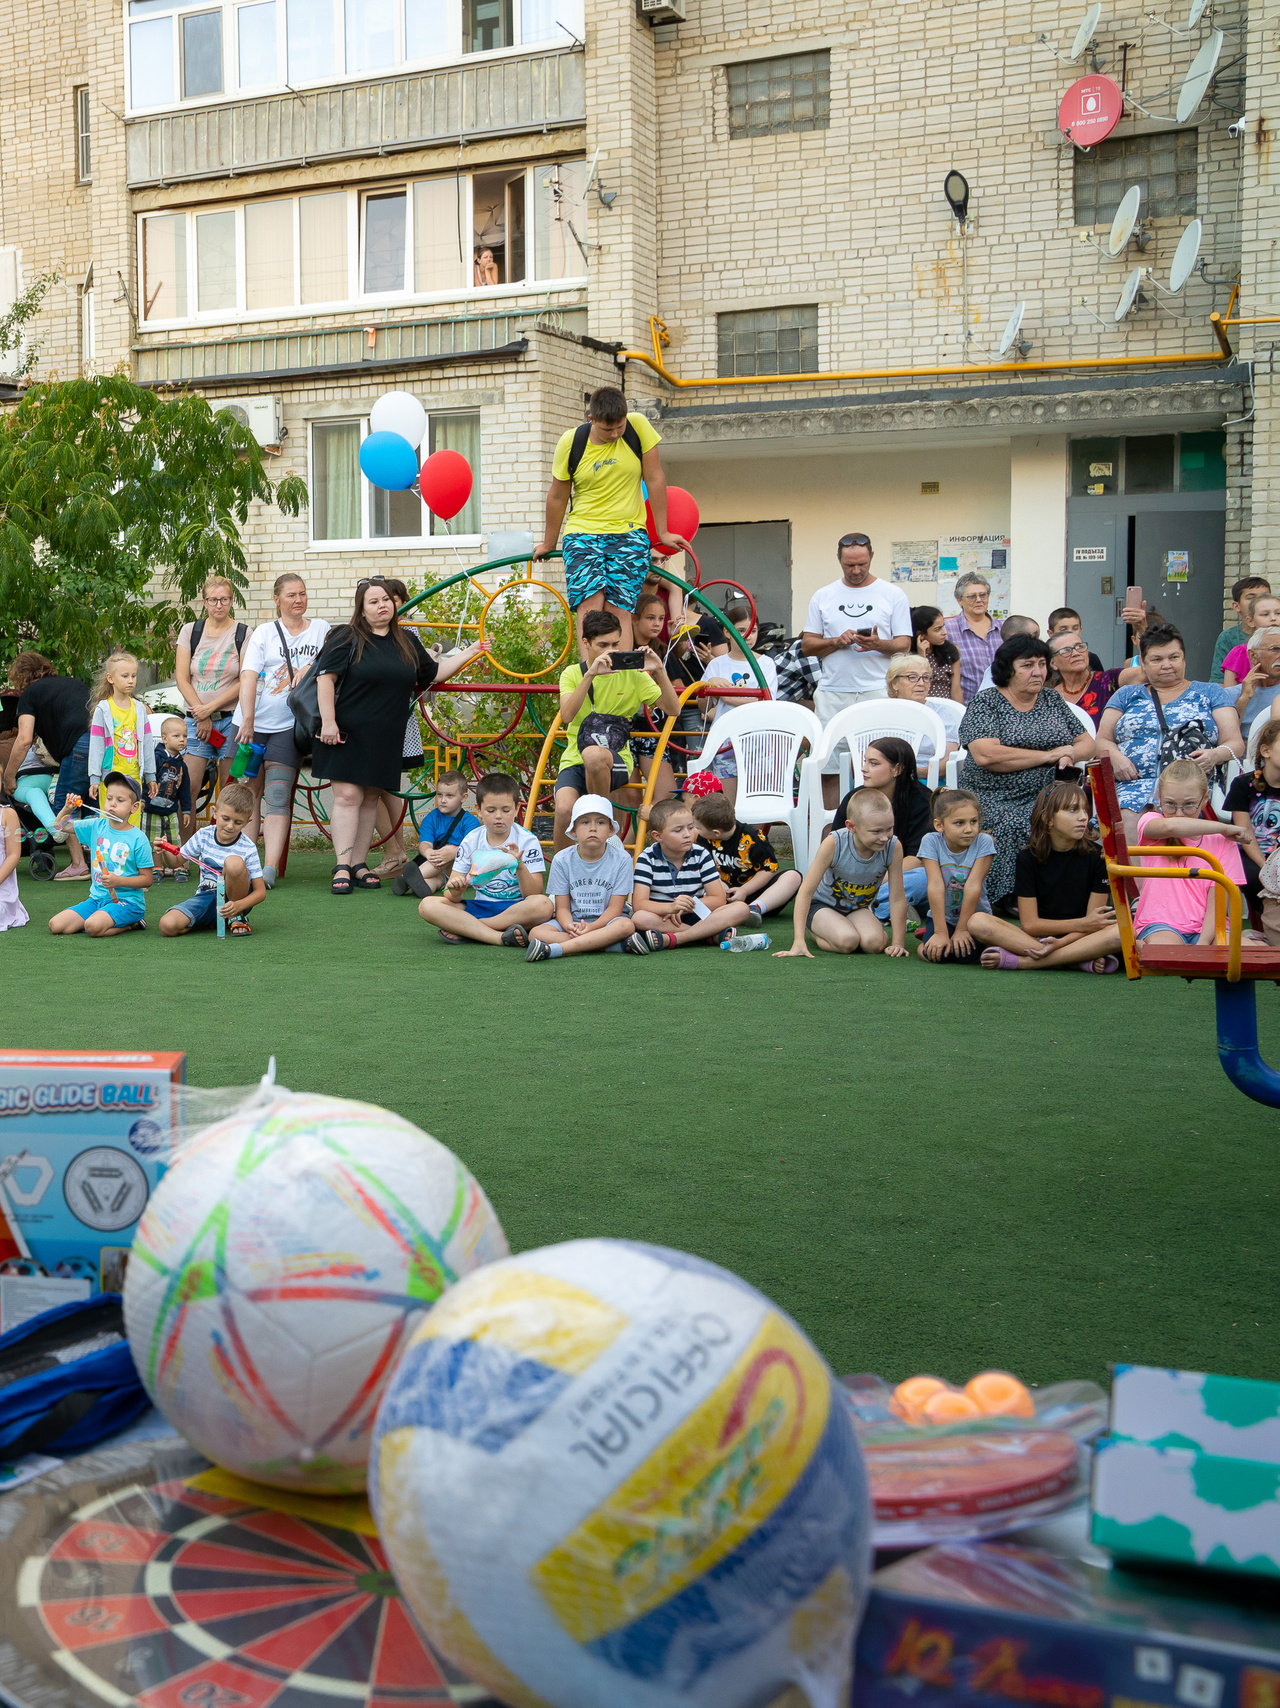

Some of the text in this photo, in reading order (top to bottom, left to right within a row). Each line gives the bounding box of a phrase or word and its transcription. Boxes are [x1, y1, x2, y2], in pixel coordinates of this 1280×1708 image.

[949, 534, 1006, 543] ИНФОРМАЦИЯ
[711, 849, 748, 870] KING
[33, 1083, 98, 1108] GLIDE
[101, 1083, 155, 1106] BALL
[569, 1310, 733, 1470] OFFICIAL
